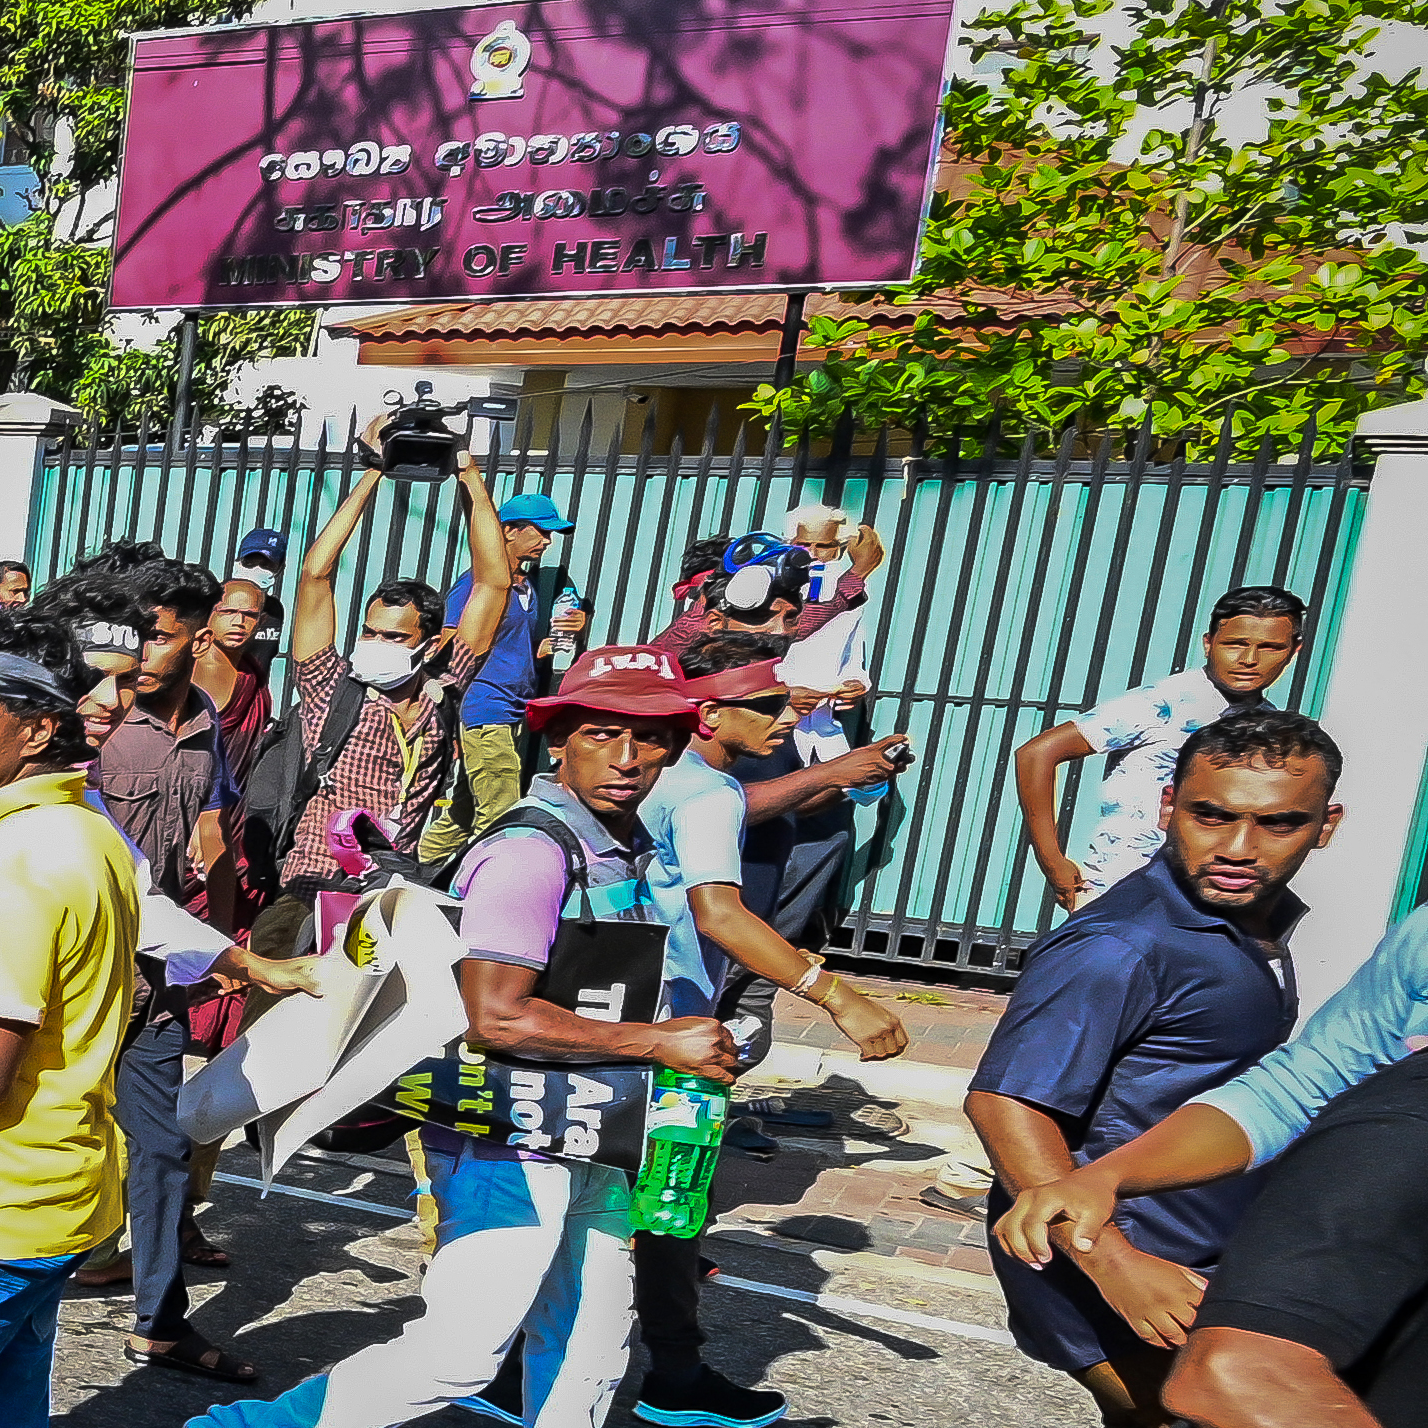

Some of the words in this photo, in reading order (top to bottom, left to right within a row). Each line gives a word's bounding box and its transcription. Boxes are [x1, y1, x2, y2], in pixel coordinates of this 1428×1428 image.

[219, 246, 442, 285] MINISTRY
[463, 242, 529, 278] OF
[550, 231, 768, 275] HEALTH
[507, 1070, 552, 1150] not
